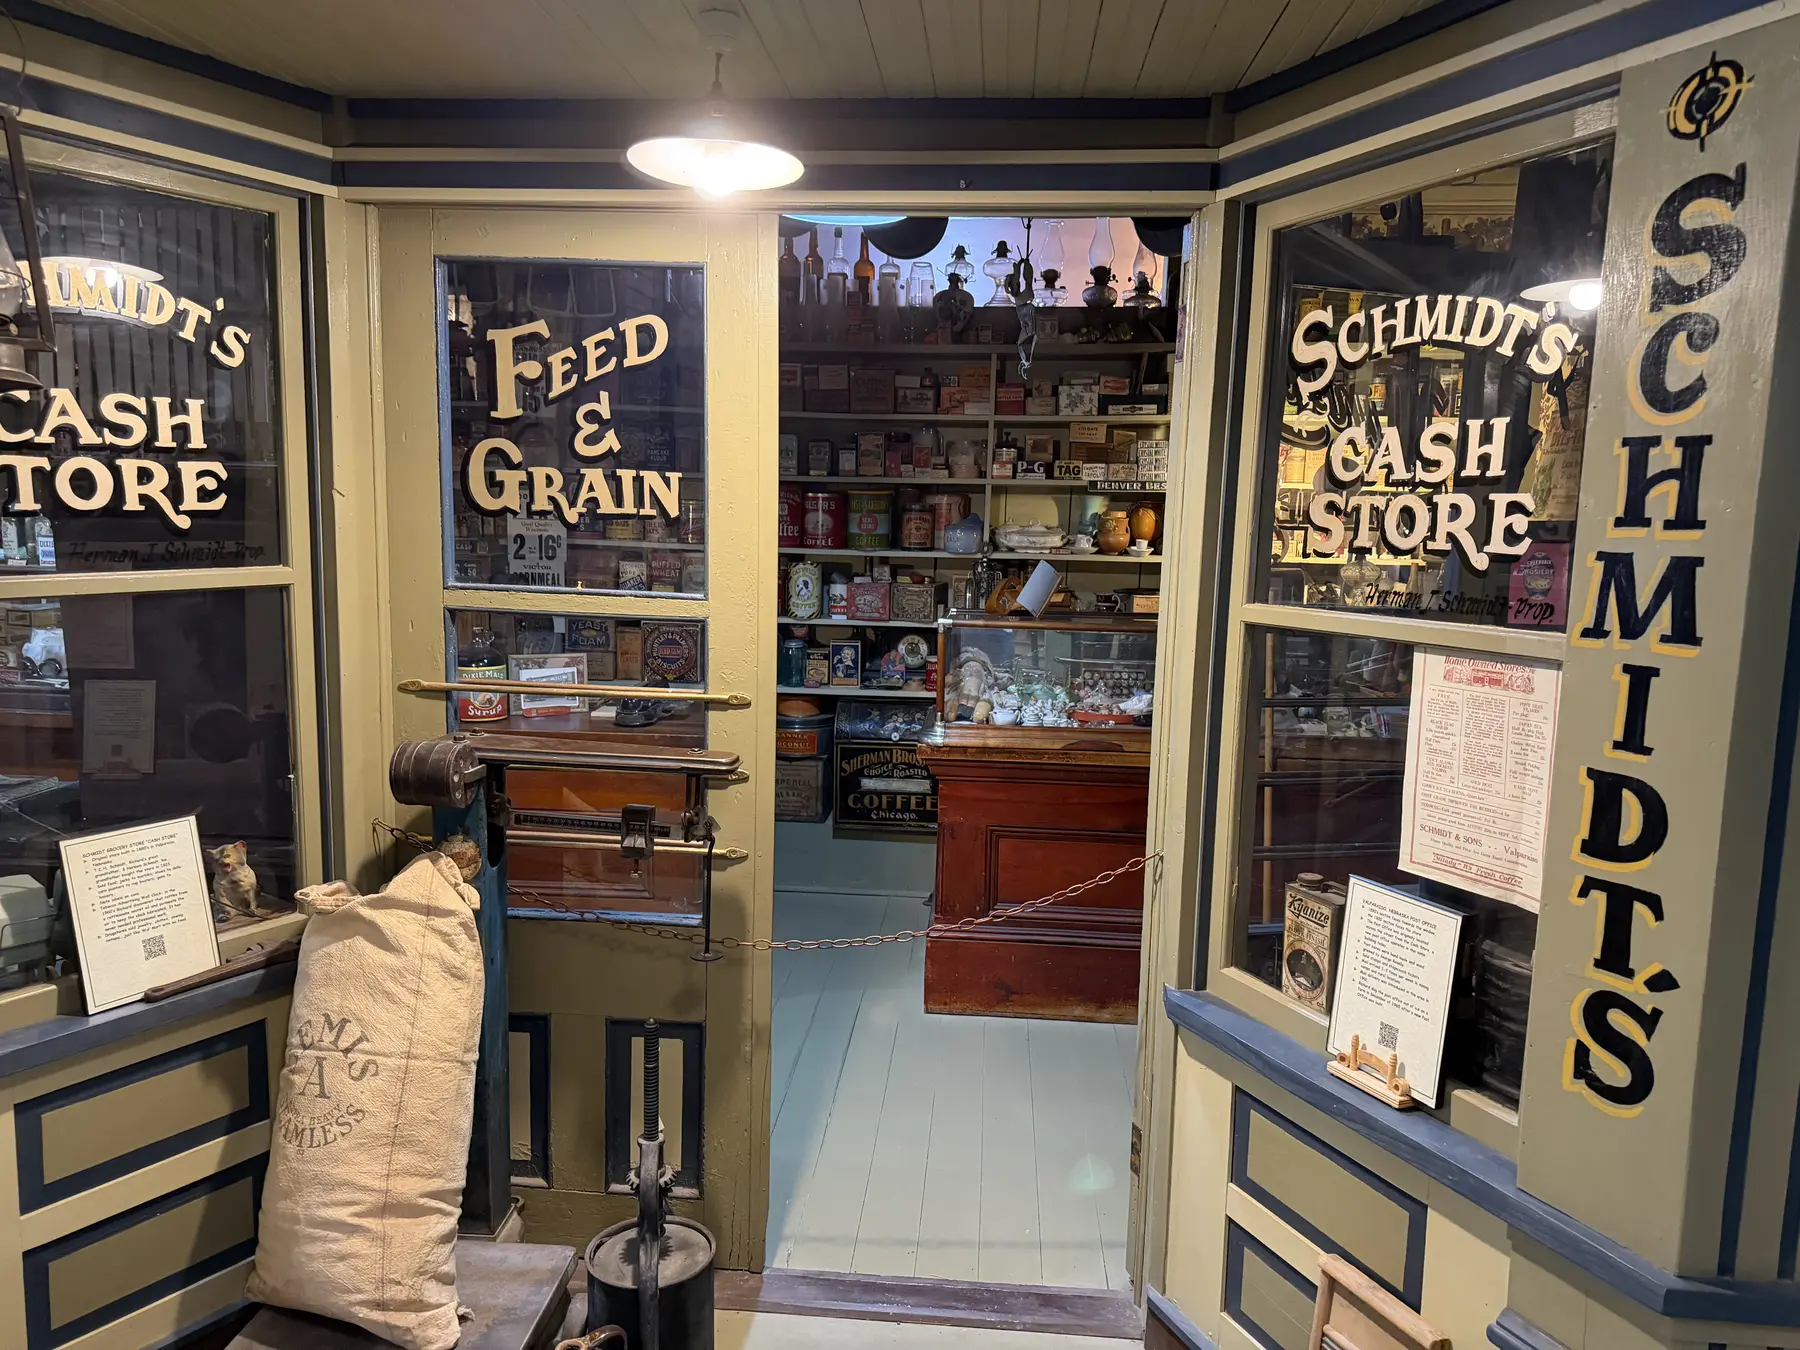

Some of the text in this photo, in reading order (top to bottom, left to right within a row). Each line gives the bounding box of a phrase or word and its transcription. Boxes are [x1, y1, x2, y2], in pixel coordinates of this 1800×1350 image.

[17, 260, 252, 369] HMIDT'S
[1292, 294, 1580, 406] SCHMIDT'S
[486, 314, 670, 419] FEED
[0, 388, 208, 449] CASH
[573, 390, 622, 456] &
[1331, 416, 1511, 483] CASH
[468, 437, 683, 524] GRAIN
[1057, 466, 1080, 476] TAG
[0, 455, 228, 529] TORE
[1097, 481, 1167, 491] DENVER BES
[805, 500, 836, 510] OLGER'S
[804, 537, 834, 546] COFFEE
[856, 537, 880, 546] COFFEE
[1309, 492, 1536, 571] STORE
[513, 533, 526, 560] 2
[652, 561, 681, 569] PUFFED
[652, 569, 681, 577] WHEAT
[1365, 582, 1421, 609] Herman
[571, 620, 609, 632] YEAST
[1570, 162, 1748, 1108] SCHMIDT'S
[571, 633, 606, 646] FOAM
[651, 633, 669, 657] HUNTLEY
[673, 633, 690, 658] PALMERS
[655, 658, 686, 670] BISCUITS
[1468, 657, 1497, 669] Owned
[1497, 661, 1526, 673] Stores
[467, 704, 502, 716] Syrup
[777, 731, 809, 740] ANNER
[841, 750, 891, 777] SHERMAN
[864, 764, 928, 778] CHOICE ROASTED
[847, 794, 938, 811] COFFEE
[870, 809, 919, 822] Chicago.
[1419, 823, 1538, 864] SCHMIDT & SONS Valparaiso
[1287, 893, 1330, 925] Kyanize
[299, 1056, 331, 1099] A
[280, 1103, 367, 1149] AMLESS
